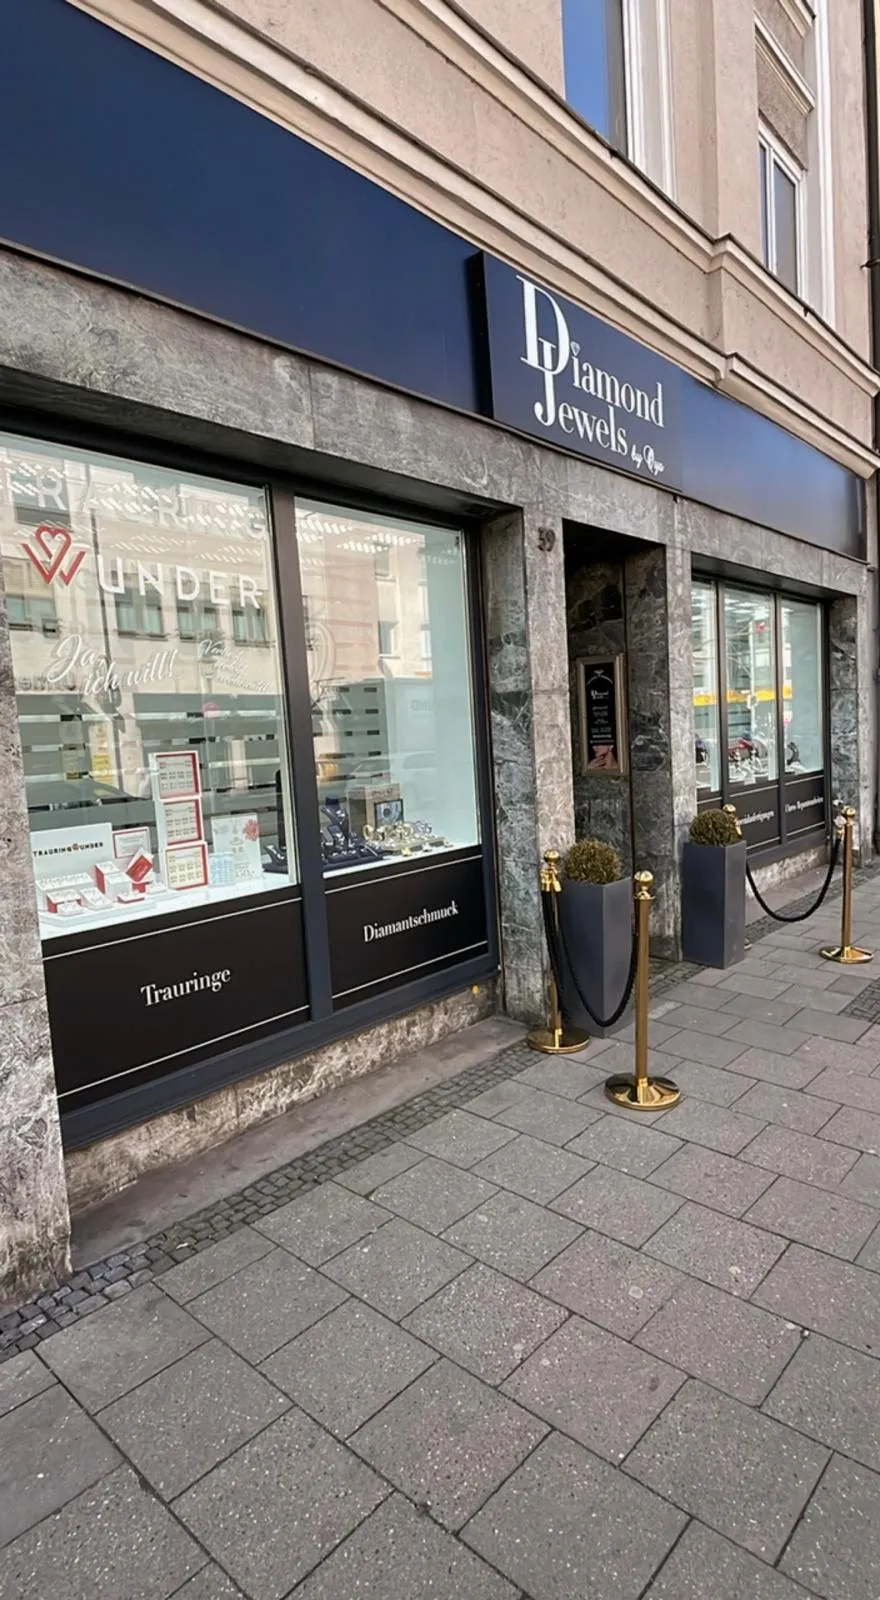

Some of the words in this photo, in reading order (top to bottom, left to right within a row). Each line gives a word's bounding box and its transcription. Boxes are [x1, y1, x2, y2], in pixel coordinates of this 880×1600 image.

[516, 274, 665, 428] Diamond
[534, 337, 628, 456] Jewels
[631, 443, 643, 470] by
[127, 648, 178, 687] will!
[363, 899, 459, 943] Diamantschmuck
[140, 968, 231, 1007] Trauringe
